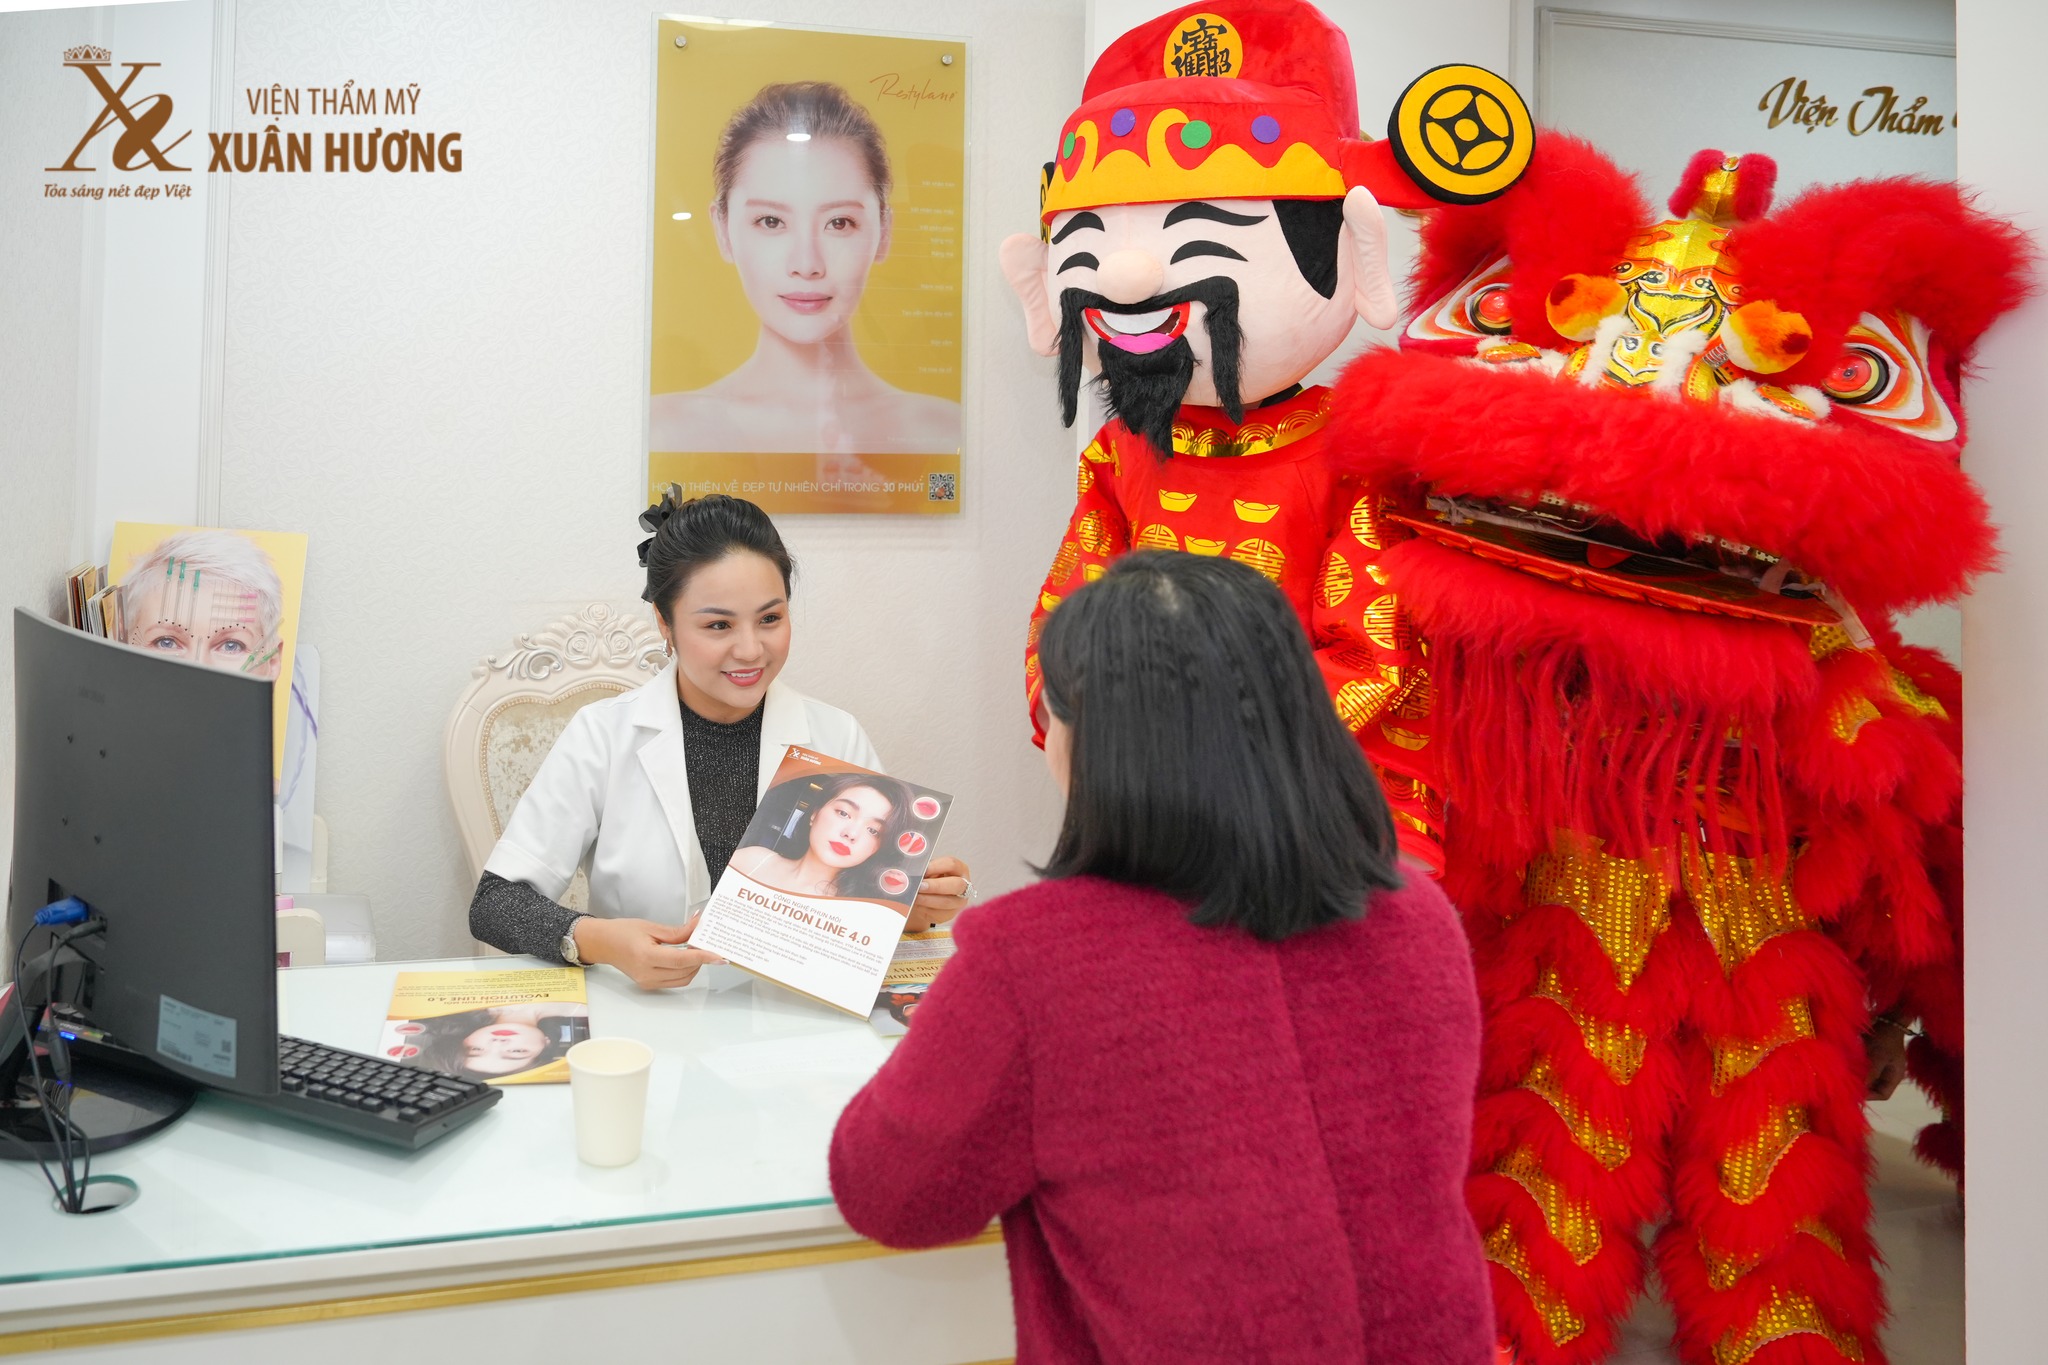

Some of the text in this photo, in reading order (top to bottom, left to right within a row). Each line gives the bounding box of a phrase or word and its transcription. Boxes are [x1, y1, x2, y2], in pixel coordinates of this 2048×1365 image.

[1758, 77, 1838, 134] Viện
[689, 480, 721, 494] THIỆN
[723, 479, 738, 493] VẺ
[743, 481, 765, 494] ĐẸP
[768, 481, 782, 494] TỰ
[784, 481, 819, 493] NHIÊN
[821, 479, 841, 493] CHỈ
[844, 482, 880, 493] TRONG
[883, 482, 895, 492] 30
[898, 480, 925, 493] PHÚT
[737, 887, 871, 946] EVOLUTION LINE 4.0
